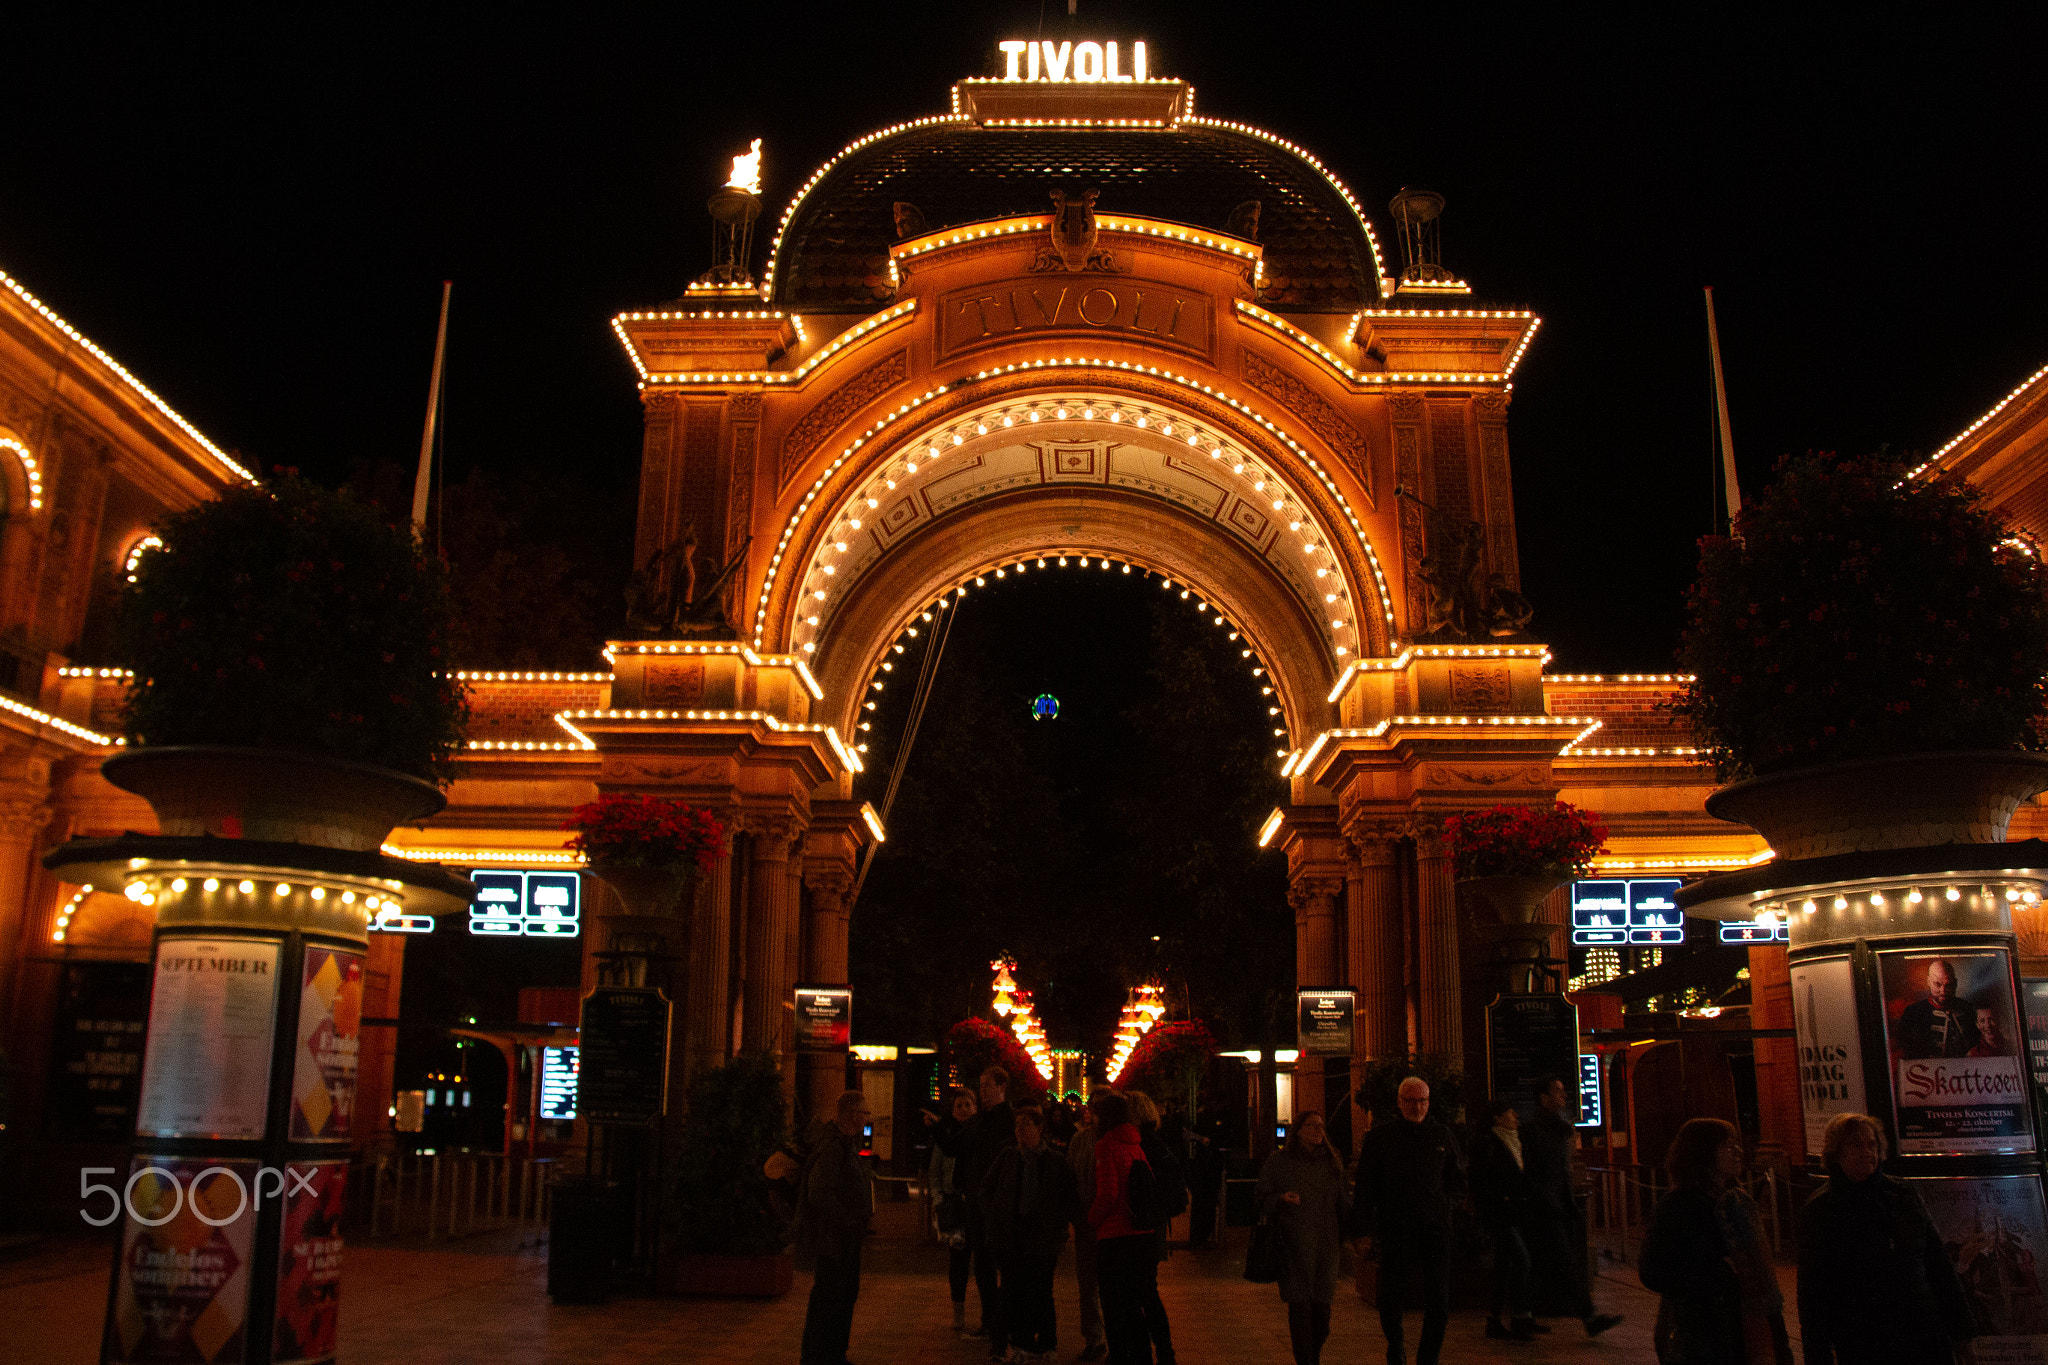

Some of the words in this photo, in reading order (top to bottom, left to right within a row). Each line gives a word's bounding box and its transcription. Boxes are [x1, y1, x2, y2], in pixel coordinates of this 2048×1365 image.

[999, 40, 1146, 83] TIVOLI
[958, 287, 1186, 337] TIVOLI
[1514, 1001, 1550, 1012] TIVOLI
[1905, 1064, 2021, 1099] Skatteøen
[1973, 1117, 2004, 1126] oktober
